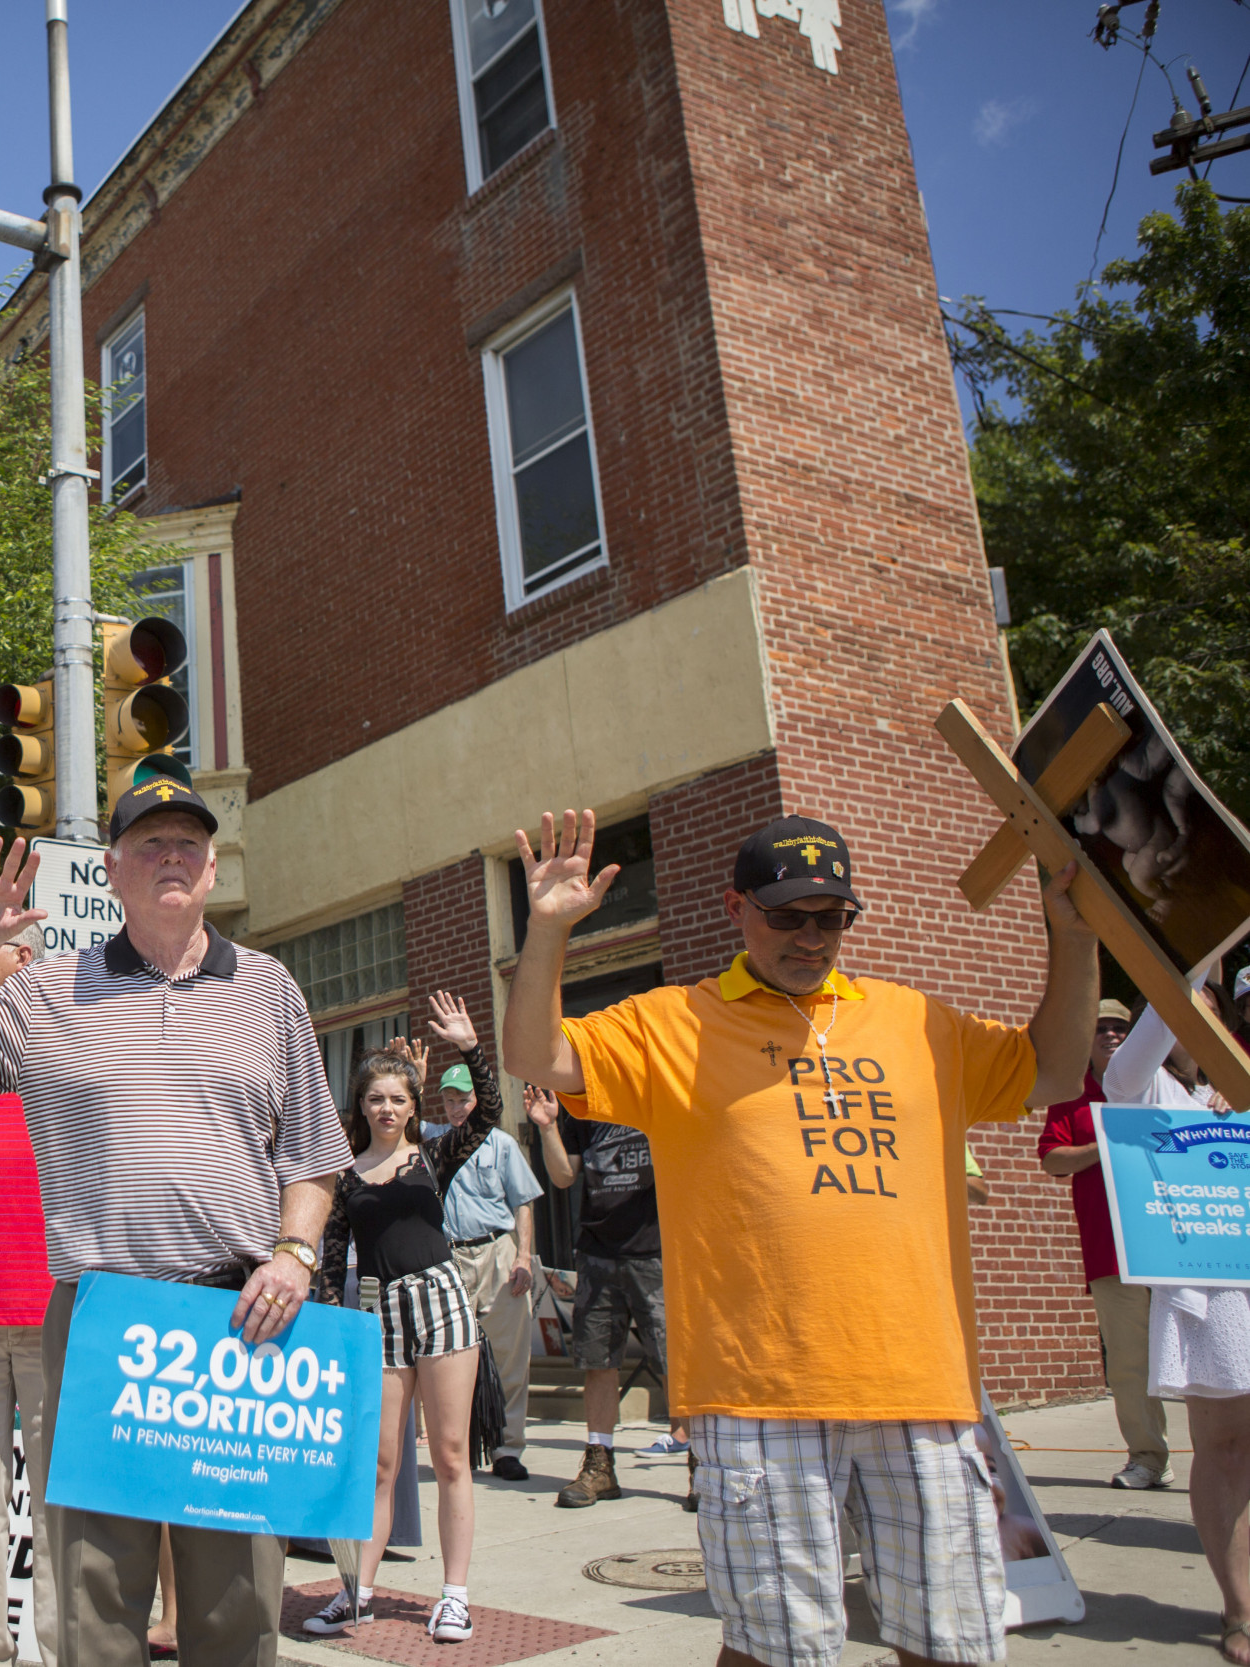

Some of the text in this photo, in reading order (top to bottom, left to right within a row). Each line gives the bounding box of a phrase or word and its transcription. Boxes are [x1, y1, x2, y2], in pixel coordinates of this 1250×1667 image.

[1091, 651, 1134, 718] AUL.ORG
[71, 861, 109, 887] NO
[59, 893, 123, 923] TURN
[43, 926, 76, 950] ON
[787, 1056, 885, 1086] PRO
[794, 1090, 896, 1122] LIFE
[801, 1127, 899, 1160] FOR
[619, 1150, 652, 1169] 196
[811, 1164, 897, 1199] ALL
[1152, 1181, 1240, 1199] Because
[1145, 1200, 1245, 1218] stops one
[1171, 1218, 1241, 1236] breaks
[117, 1323, 346, 1400] 32,000+
[110, 1382, 344, 1444] ABORTIONS
[112, 1424, 337, 1467] IN PENNSYLVANIA EVERY YEAR.
[191, 1459, 269, 1484] #tragictruth
